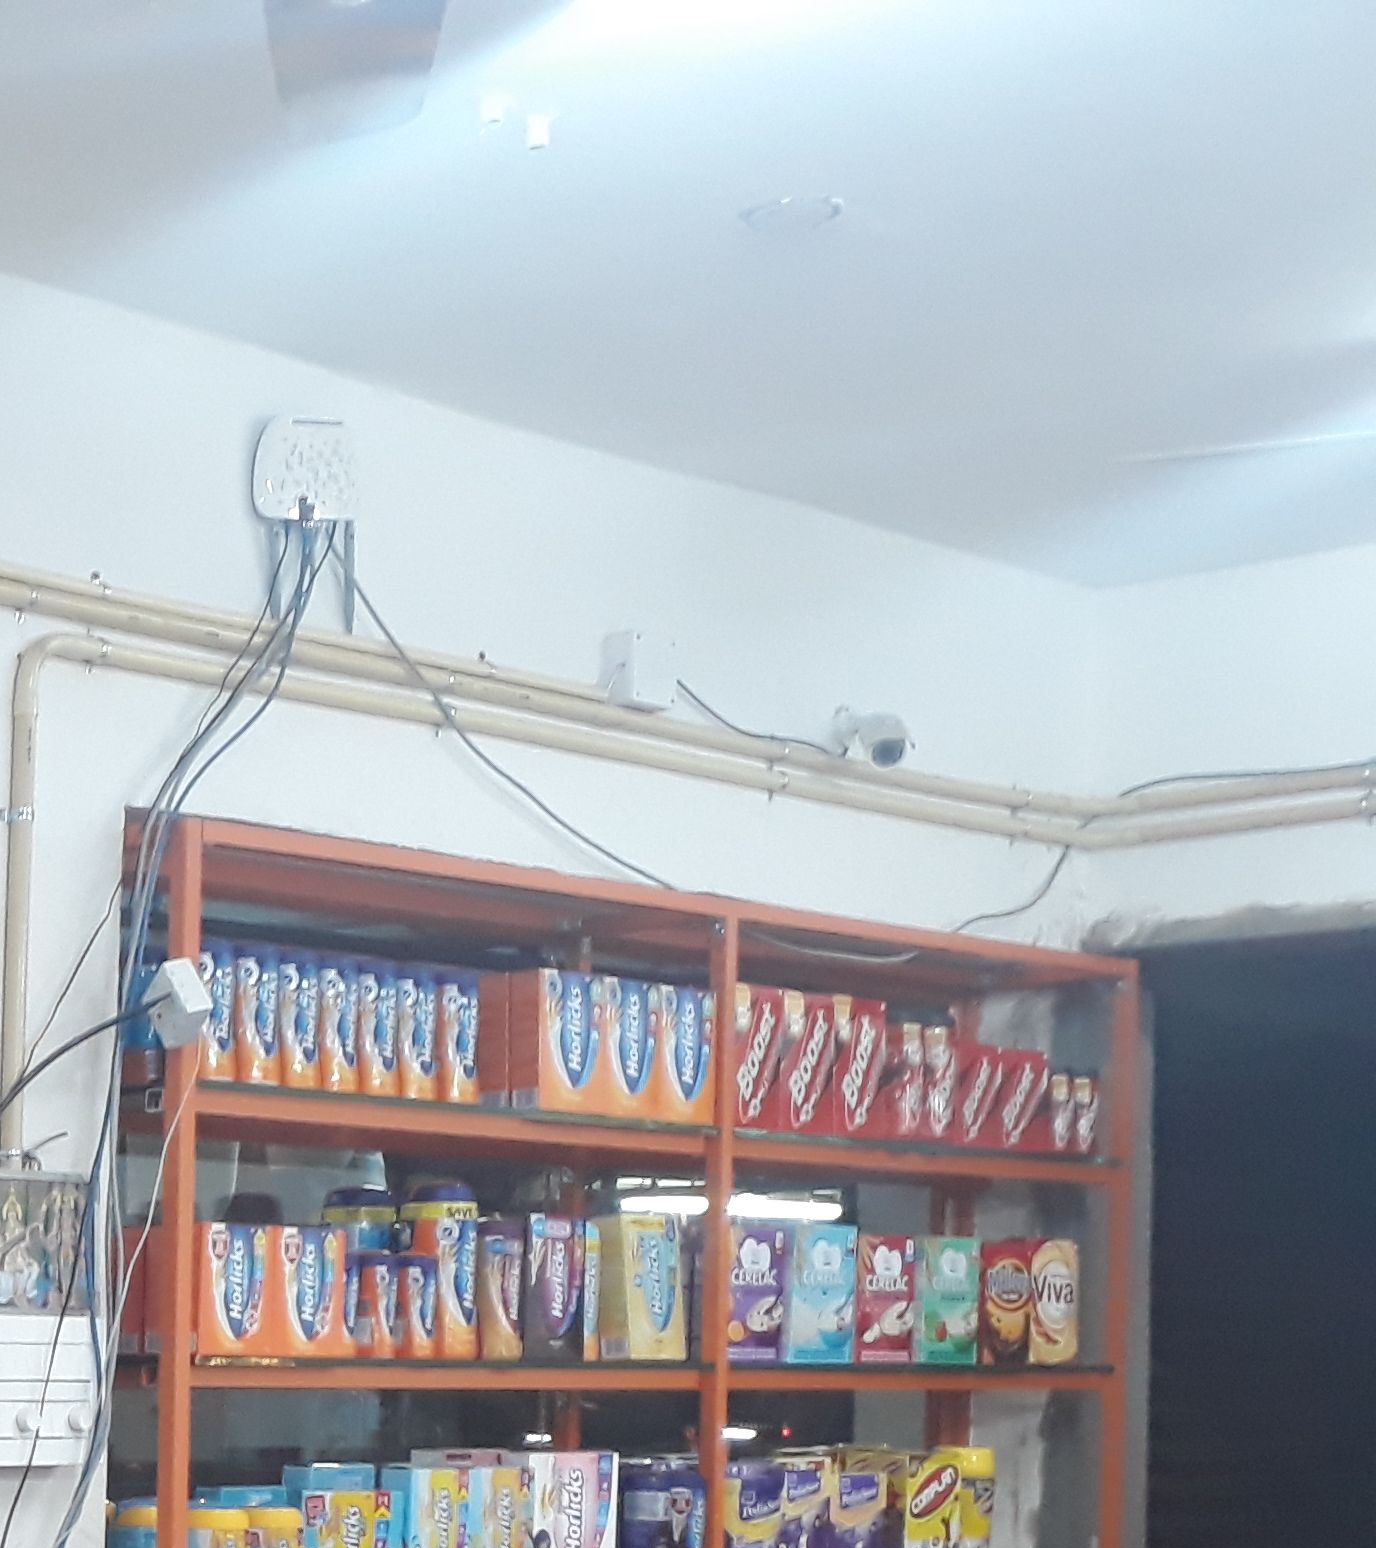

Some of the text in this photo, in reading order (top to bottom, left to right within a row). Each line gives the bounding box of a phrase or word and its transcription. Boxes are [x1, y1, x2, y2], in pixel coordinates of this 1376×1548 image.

[568, 986, 583, 1072] Horlicks
[626, 992, 639, 1078] Horlicks
[736, 1002, 775, 1101] BOOST
[789, 1008, 828, 1105] BOOST
[842, 1015, 875, 1109] BOOST
[230, 1239, 244, 1319] Horlicks
[300, 1244, 316, 1322] Horlicks
[1032, 1275, 1075, 1304] Viva
